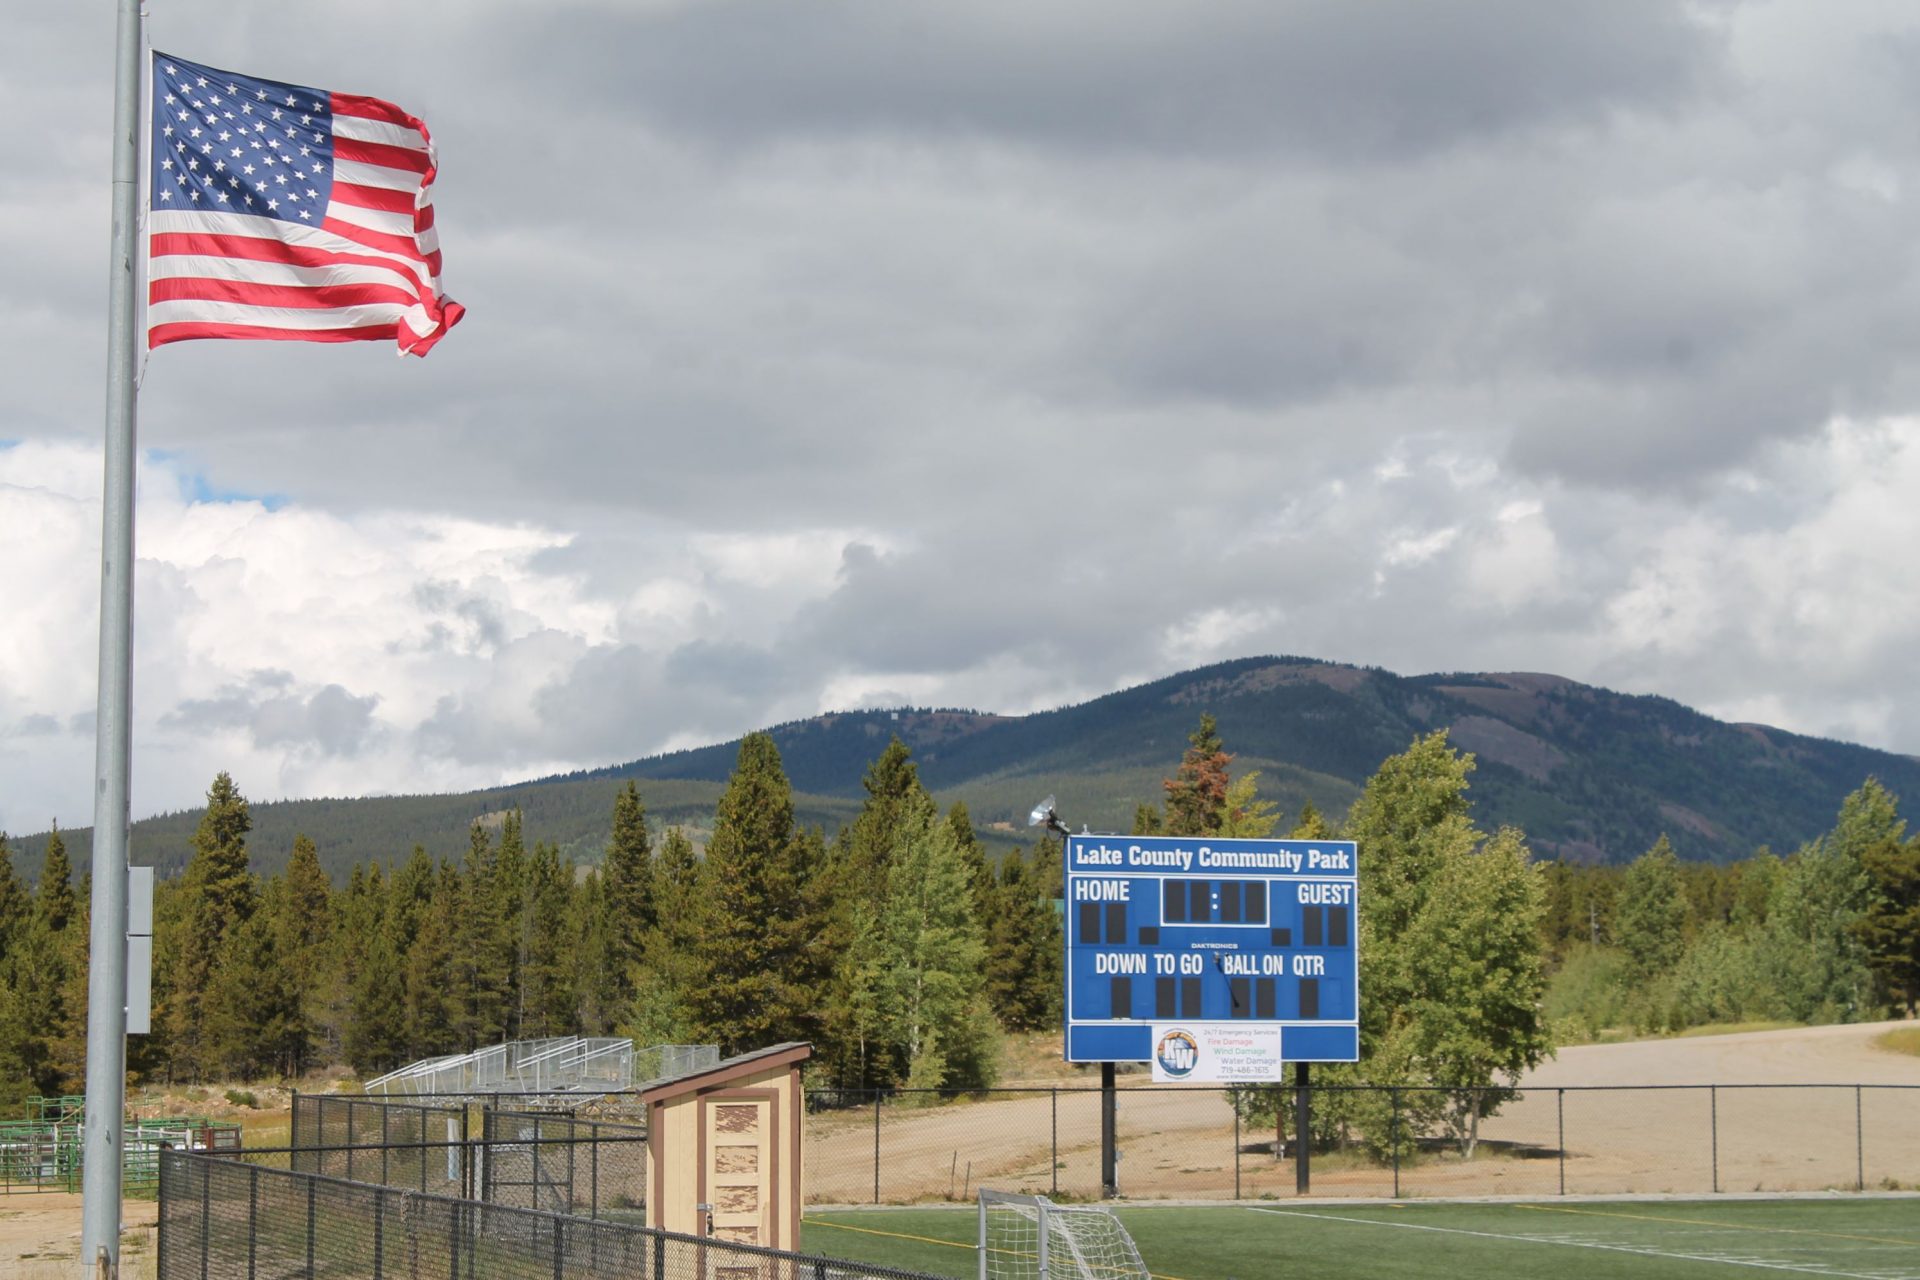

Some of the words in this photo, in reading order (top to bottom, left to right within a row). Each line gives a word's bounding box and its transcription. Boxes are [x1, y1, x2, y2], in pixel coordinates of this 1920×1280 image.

[1076, 845, 1122, 865] Lake
[1129, 846, 1193, 870] County
[1199, 847, 1303, 872] Community
[1308, 850, 1350, 869] Park
[1075, 880, 1130, 901] HOME
[1298, 884, 1352, 904] GUEST
[1096, 953, 1147, 974] DOWN
[1154, 954, 1176, 974] TO
[1180, 953, 1203, 975] GO
[1224, 954, 1260, 975] BALL
[1263, 954, 1283, 975] ON
[1293, 955, 1325, 976] QTR
[1223, 1038, 1253, 1046] Damage
[1235, 1047, 1266, 1055] Damage
[1246, 1057, 1277, 1066] Damage
